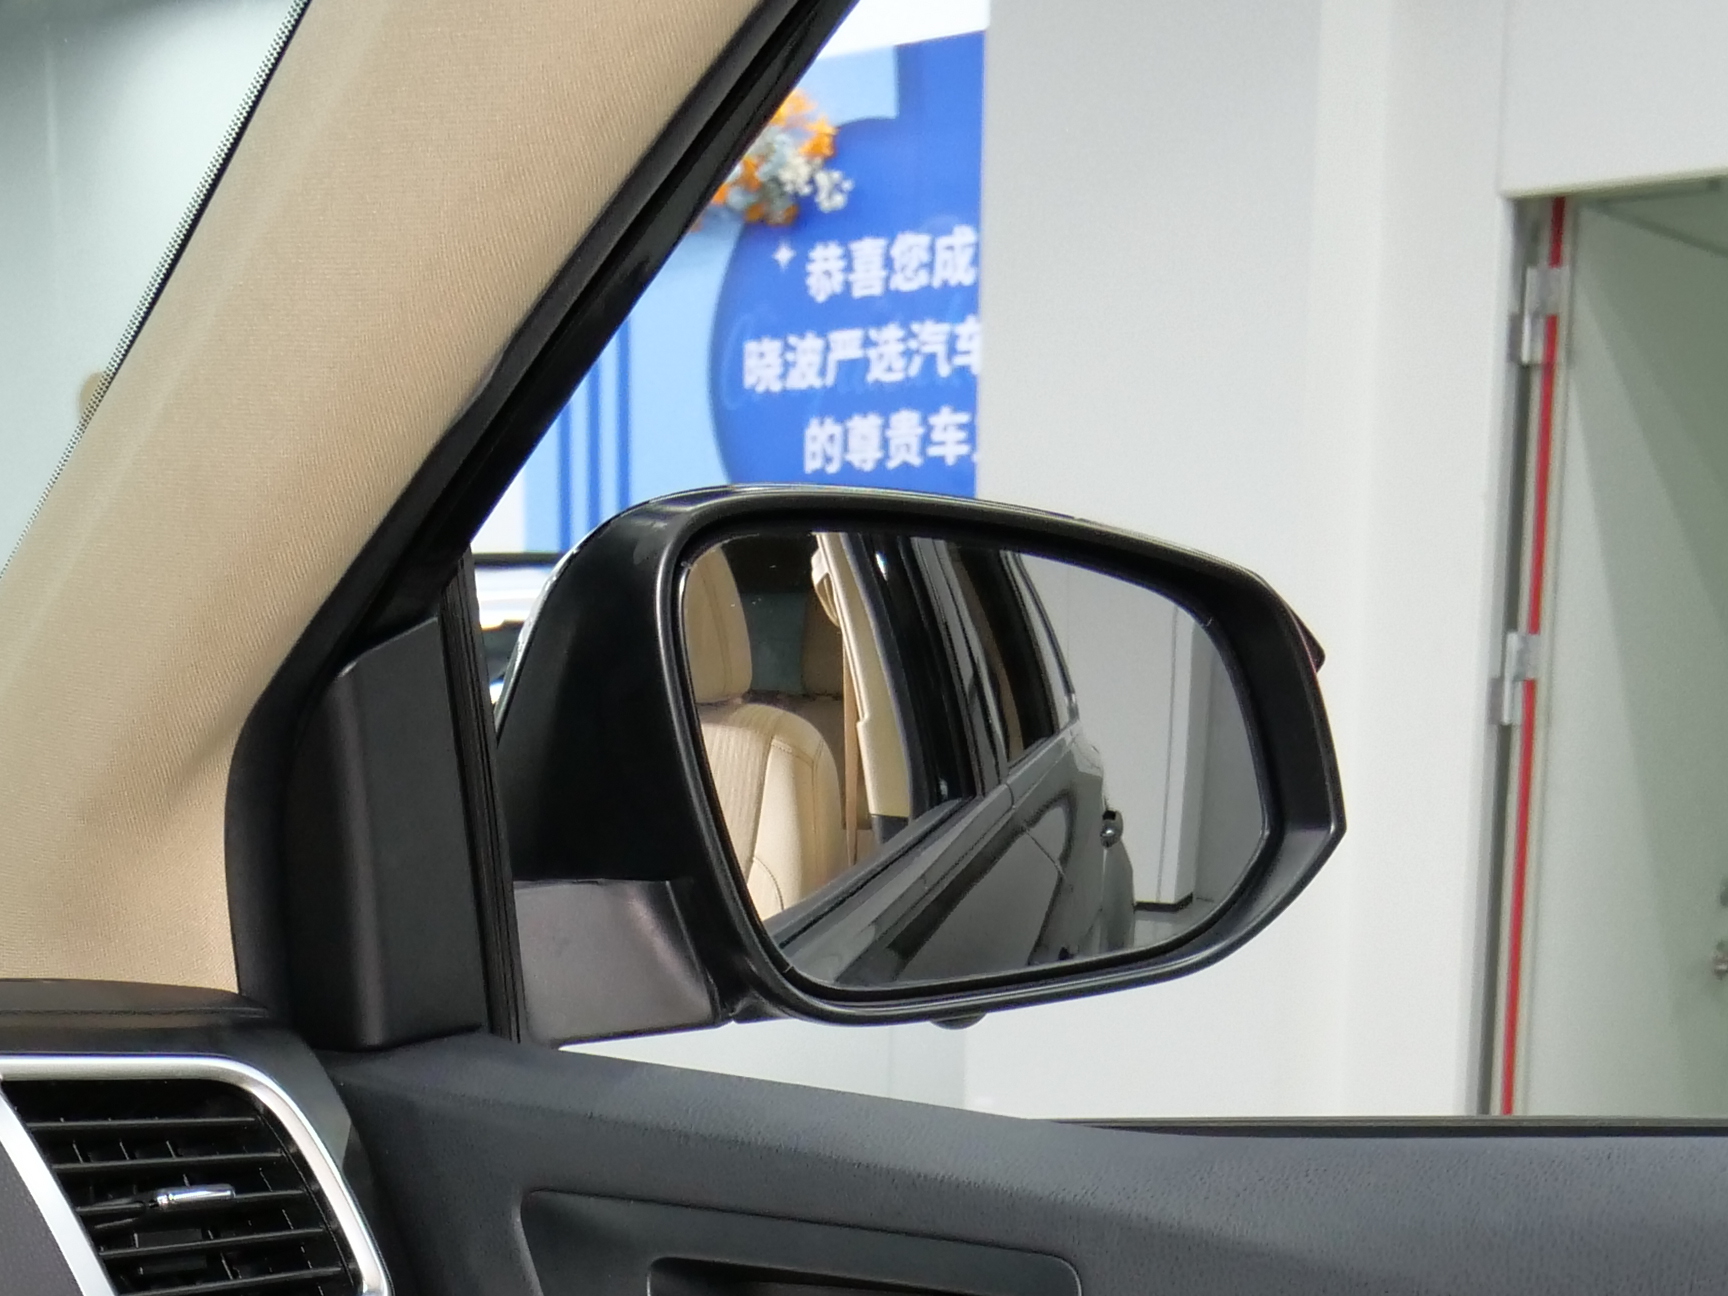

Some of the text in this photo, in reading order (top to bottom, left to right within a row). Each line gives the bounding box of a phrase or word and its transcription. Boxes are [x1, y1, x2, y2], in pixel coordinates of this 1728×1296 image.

[807, 225, 978, 303] 恭喜您成
[742, 317, 981, 393] 晓波严选汽车
[804, 406, 978, 474] 的尊贵车
